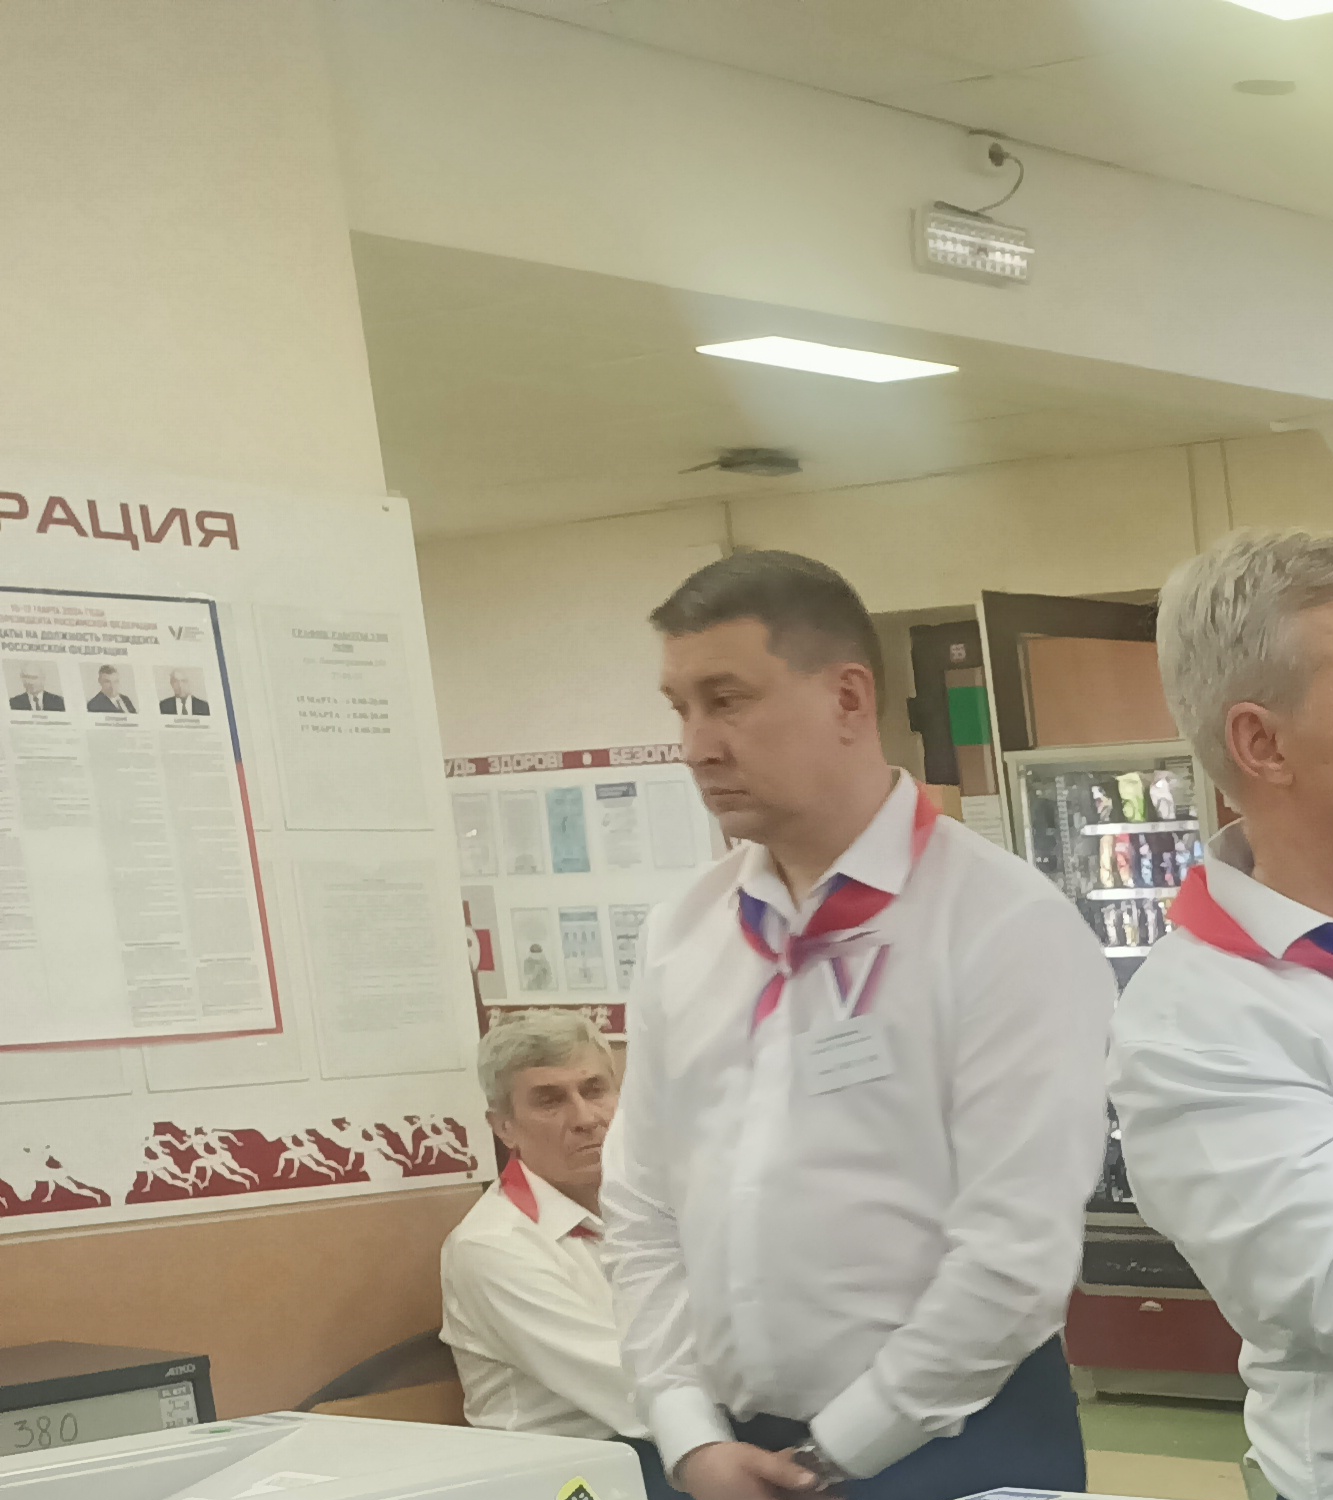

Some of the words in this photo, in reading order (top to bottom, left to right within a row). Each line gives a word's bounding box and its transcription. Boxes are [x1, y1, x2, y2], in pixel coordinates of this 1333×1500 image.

[0, 491, 239, 551] РАЦИЯ
[446, 758, 476, 777] УДЬ
[610, 744, 683, 764] БЕЗОПА
